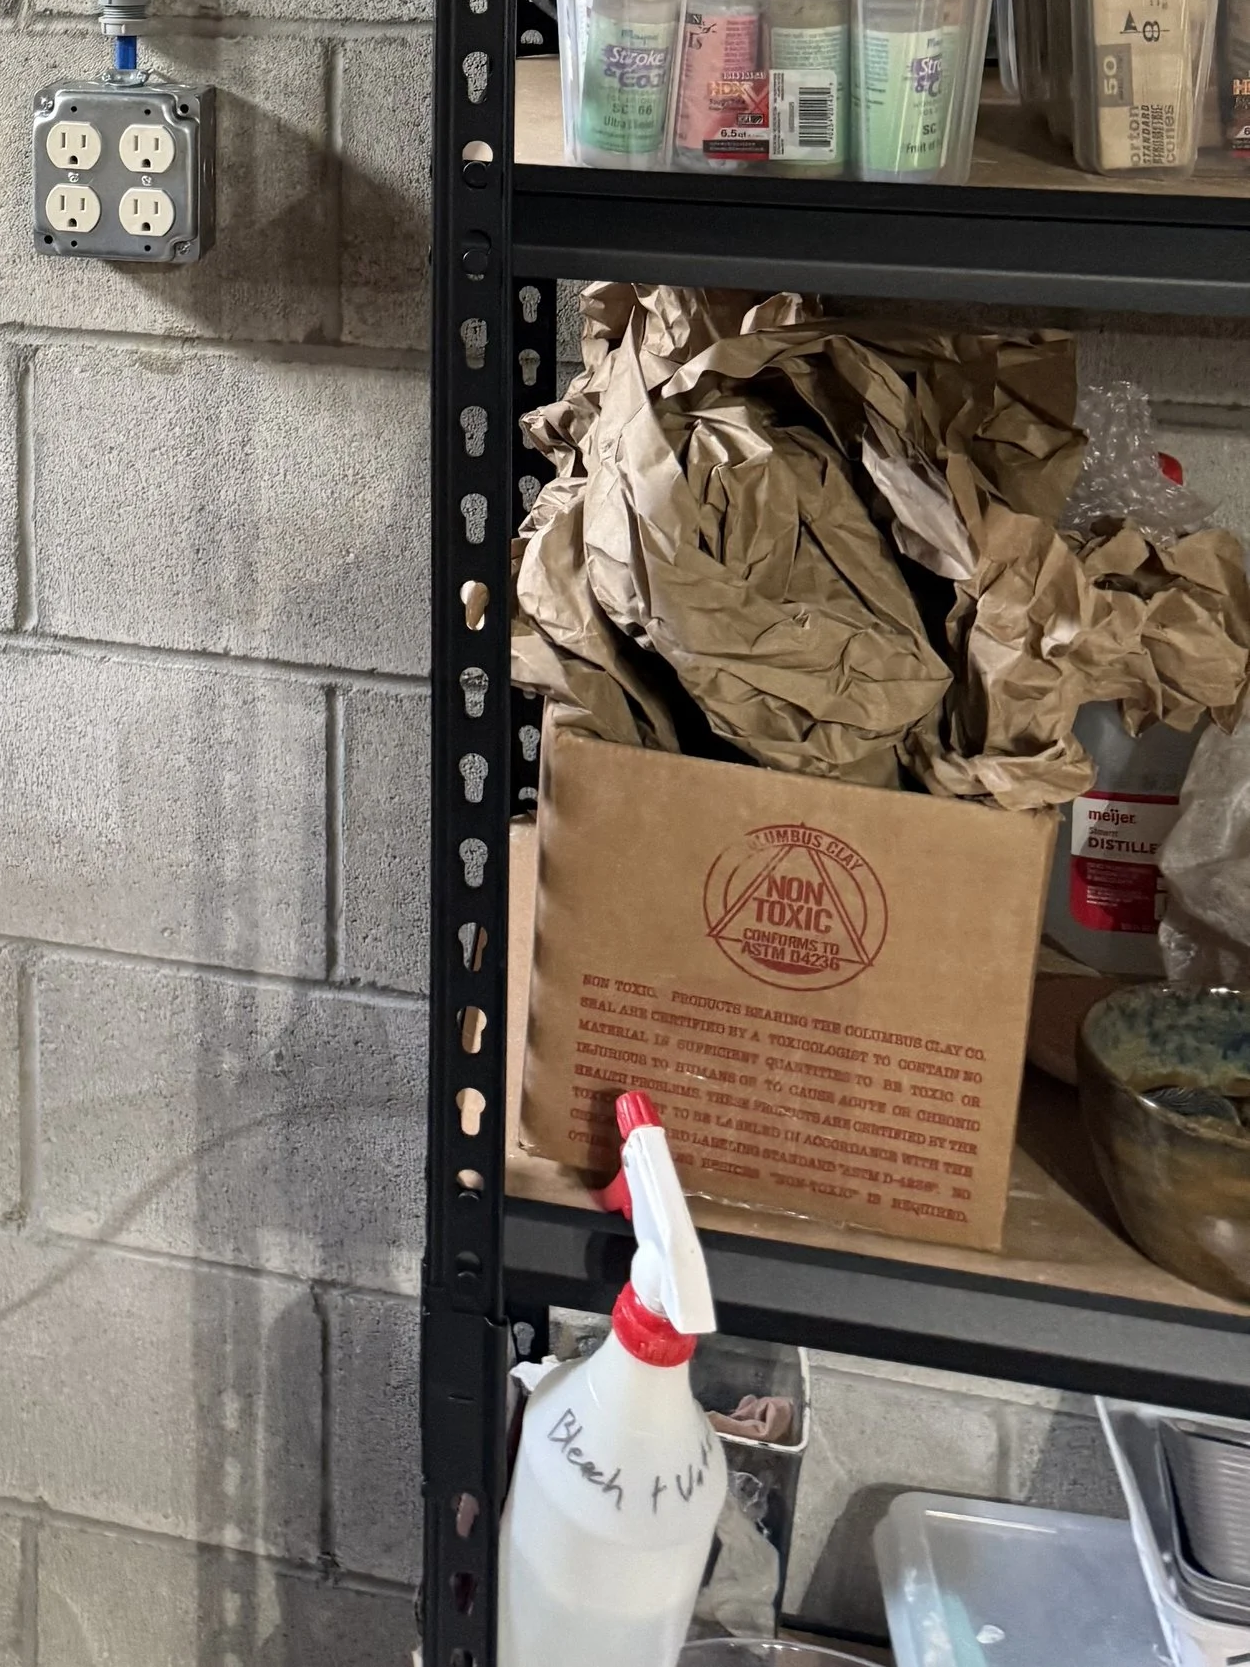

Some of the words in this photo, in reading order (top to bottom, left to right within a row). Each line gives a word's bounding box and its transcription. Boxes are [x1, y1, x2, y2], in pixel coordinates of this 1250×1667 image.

[609, 46, 664, 67] Stroke
[1142, 20, 1161, 43] 8
[1103, 56, 1118, 96] 50
[922, 122, 937, 136] SC
[1127, 105, 1142, 167] orton
[1140, 104, 1152, 165] STANDARD
[1150, 104, 1165, 165] PYROMETRIC
[1163, 104, 1176, 165] cones
[1088, 808, 1135, 826] meijer
[825, 840, 864, 871] CLAY
[1087, 836, 1159, 855] DISTILLE
[752, 896, 833, 935] TOXIC
[766, 874, 826, 908] NON
[741, 941, 786, 961] ASTM
[789, 949, 840, 972] D4236
[743, 927, 819, 953] CONFORMS
[820, 941, 840, 956] TO
[580, 996, 616, 1013] SEAL
[620, 1005, 648, 1021] ARE
[651, 1010, 725, 1035] CERTIFIED
[728, 1026, 749, 1040] BY
[750, 1031, 761, 1042] A
[768, 1033, 869, 1063] TOXICOLOGIST
[872, 1053, 891, 1067] TO
[898, 1058, 960, 1080] CONTAIN
[962, 1070, 983, 1084] NO
[583, 974, 610, 986] NON
[671, 990, 742, 1015] PRODUCTS
[745, 1005, 808, 1028] BEARING
[811, 1018, 842, 1034] THE
[844, 1024, 923, 1049] COLUMBUS
[925, 1039, 963, 1057] CLAY
[965, 1046, 987, 1062] CO.
[575, 1041, 647, 1066] INJURIOUS
[651, 1056, 669, 1070] TO
[674, 1060, 737, 1085] HUMANS
[739, 1073, 758, 1087] OR
[764, 1078, 783, 1093] TO
[788, 1084, 836, 1104] CAUSE
[838, 1094, 887, 1114] ACUTE
[892, 1104, 911, 1118] OR
[916, 1109, 981, 1132] CHRONIC
[578, 1018, 650, 1044] MATERIAL
[653, 1034, 670, 1047] IS
[676, 1038, 760, 1065] SUFFICIENT
[765, 1056, 851, 1083] QUANTITIES
[855, 1073, 873, 1087] TO
[883, 1079, 903, 1093] BE
[910, 1084, 954, 1103] TOXIC
[960, 1094, 981, 1108] OR
[574, 1063, 628, 1085] HEALTH
[706, 1090, 750, 1110] THESE
[753, 1099, 821, 1125] PRODUCTS
[821, 1114, 851, 1130] ARE
[853, 1121, 926, 1145] CERTIFIED
[928, 1135, 948, 1149] BY
[948, 1140, 978, 1155] THE
[672, 1106, 690, 1120] TO
[693, 1110, 712, 1124] BE
[783, 1130, 800, 1143] IN
[803, 1132, 898, 1163] ACCORDANCE
[901, 1152, 940, 1171] WITH
[942, 1161, 974, 1178] THE
[691, 1132, 760, 1157] LABELING
[762, 1147, 836, 1172] STANDARD
[951, 1186, 972, 1200] NO
[866, 1192, 882, 1205] IS
[547, 1408, 624, 1512] Bleach
